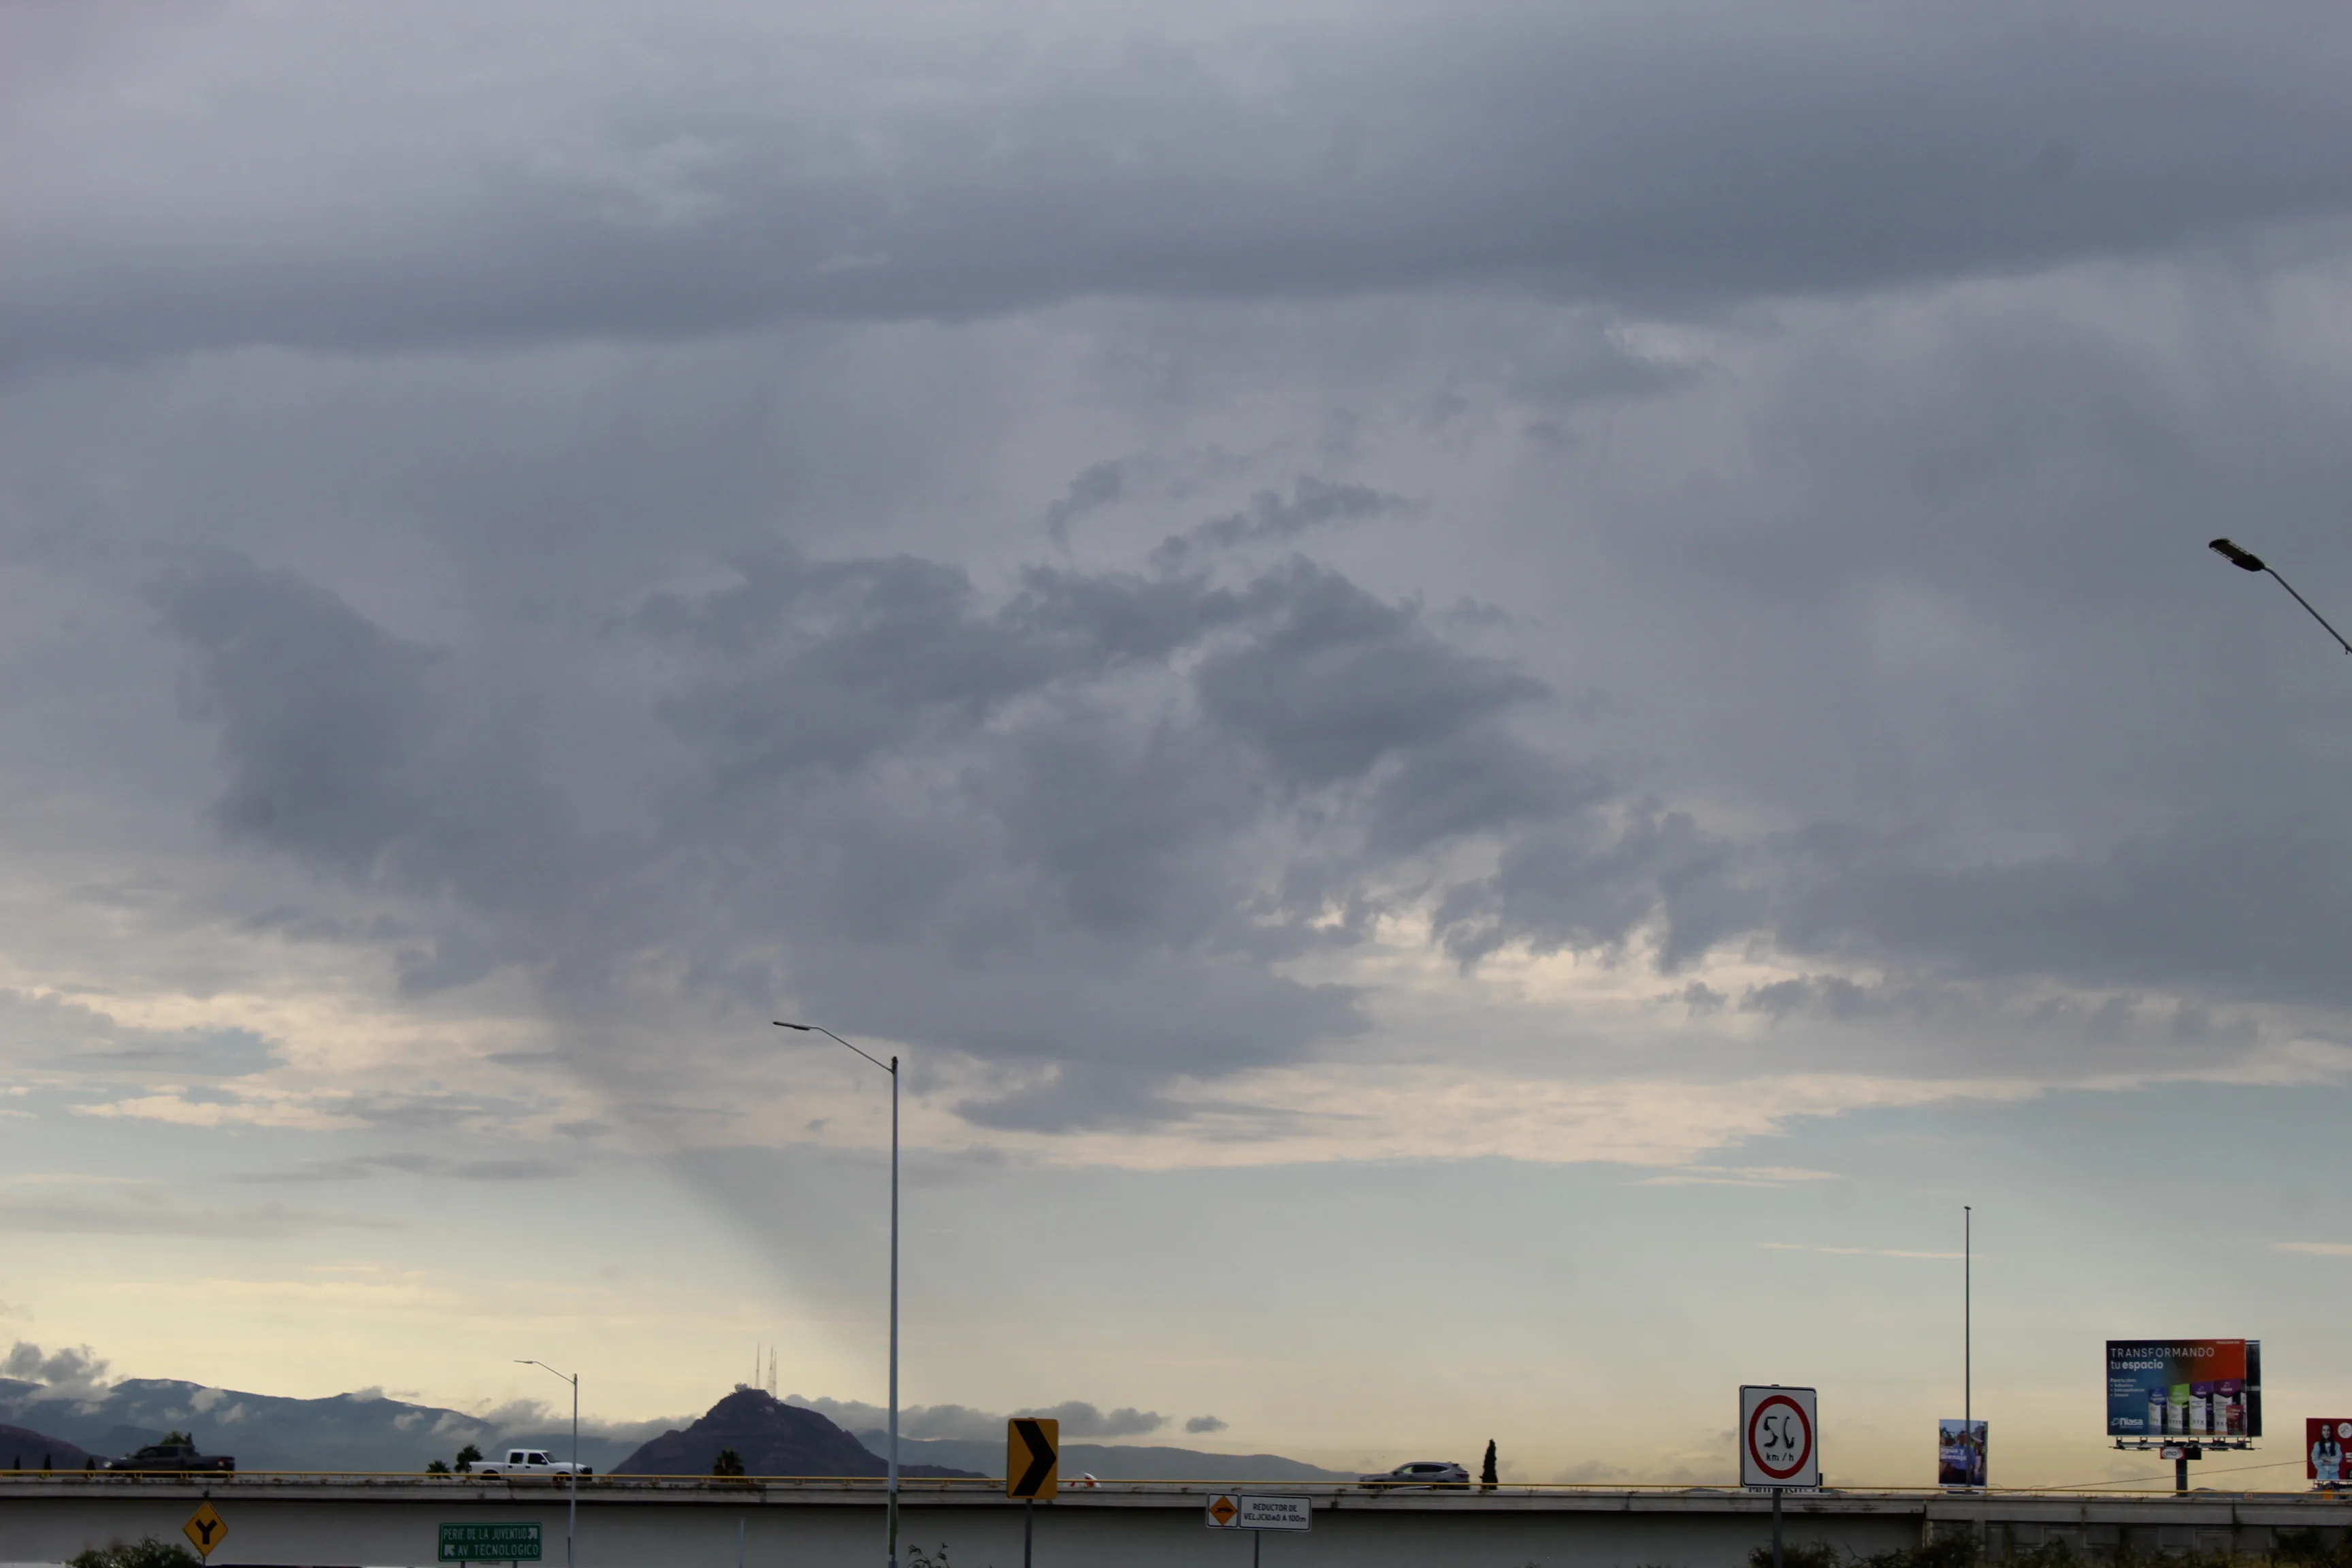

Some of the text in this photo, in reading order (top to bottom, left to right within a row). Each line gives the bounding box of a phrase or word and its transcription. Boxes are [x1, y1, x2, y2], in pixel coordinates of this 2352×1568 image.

[2110, 1347, 2215, 1358] TRANSFORMANDO
[2110, 1359, 2163, 1371] tu espacio
[2120, 1418, 2143, 1426] Niasa
[1252, 1503, 1298, 1512] REDUCTOR DE
[467, 1528, 476, 1539] DE
[479, 1528, 489, 1539] LA
[492, 1528, 527, 1539] JUVENTUD
[457, 1544, 538, 1556] AV TECNOLOGICO
